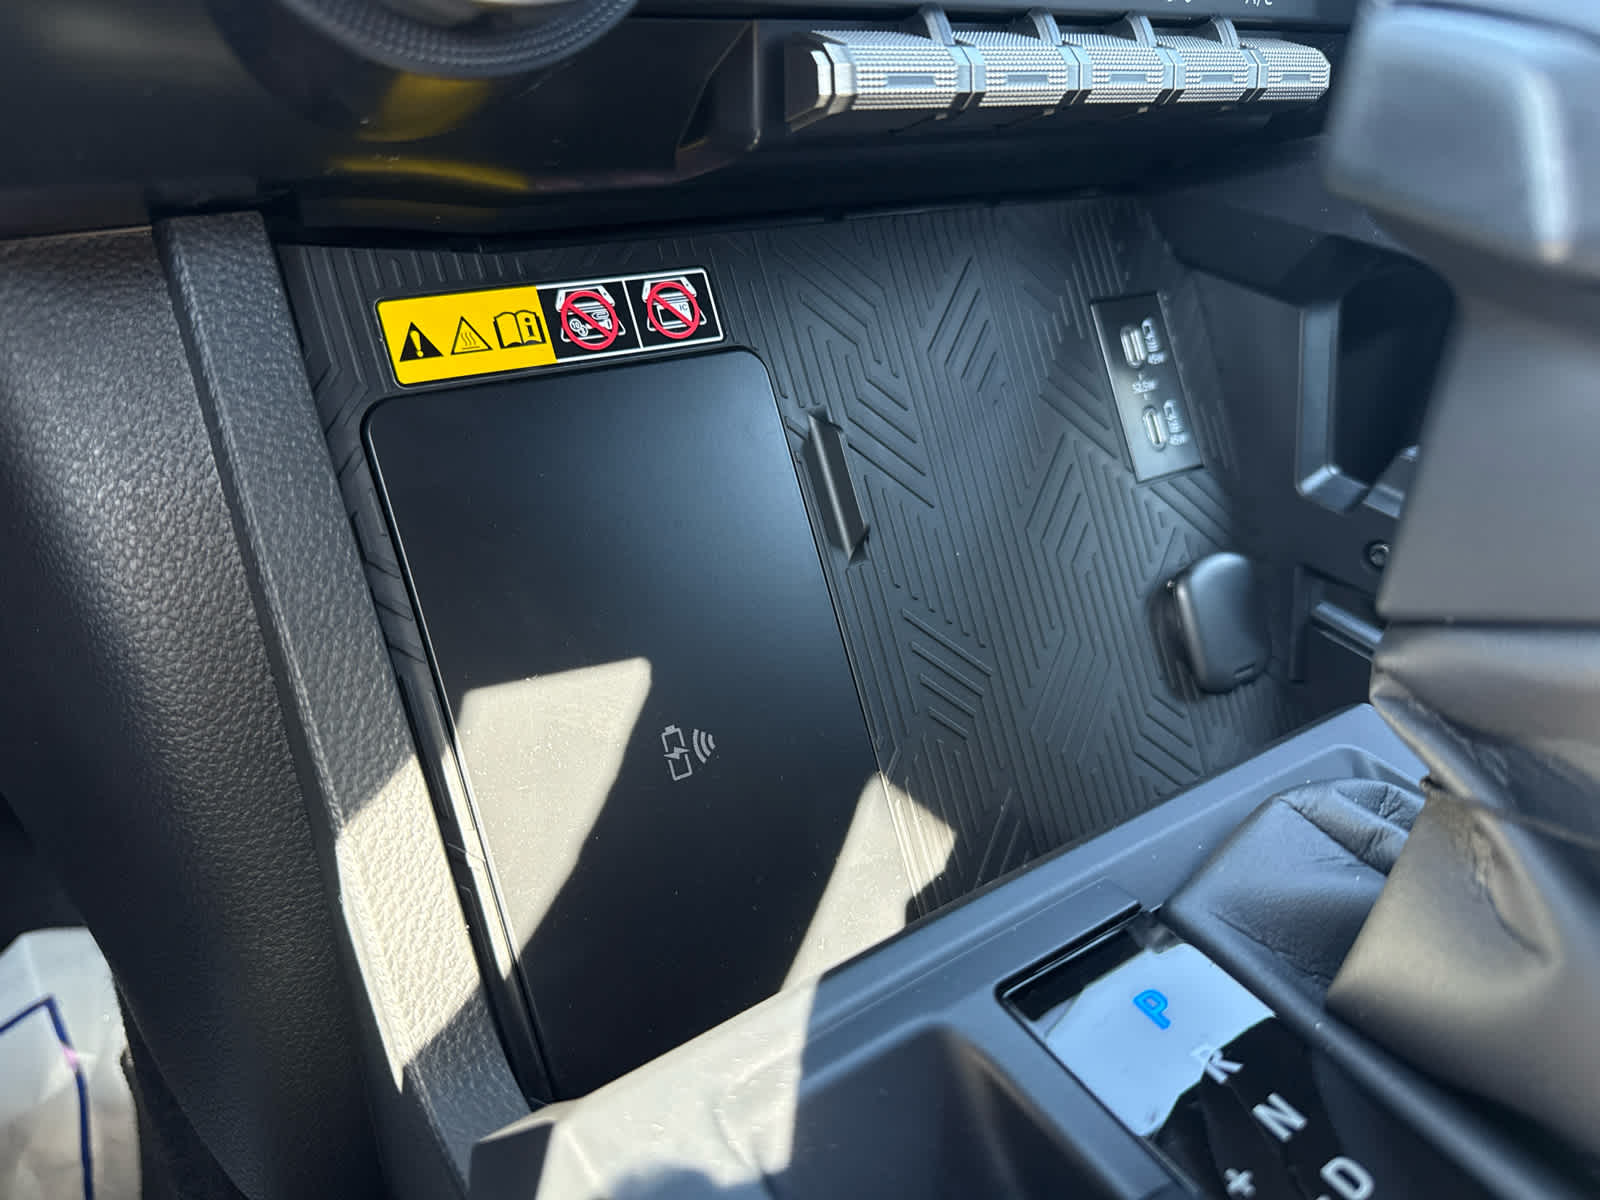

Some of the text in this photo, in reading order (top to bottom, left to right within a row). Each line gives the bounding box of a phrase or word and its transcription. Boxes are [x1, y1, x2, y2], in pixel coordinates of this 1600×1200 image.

[1133, 988, 1171, 1031] P
[1252, 1092, 1308, 1142] N
[1319, 1156, 1375, 1200] D
